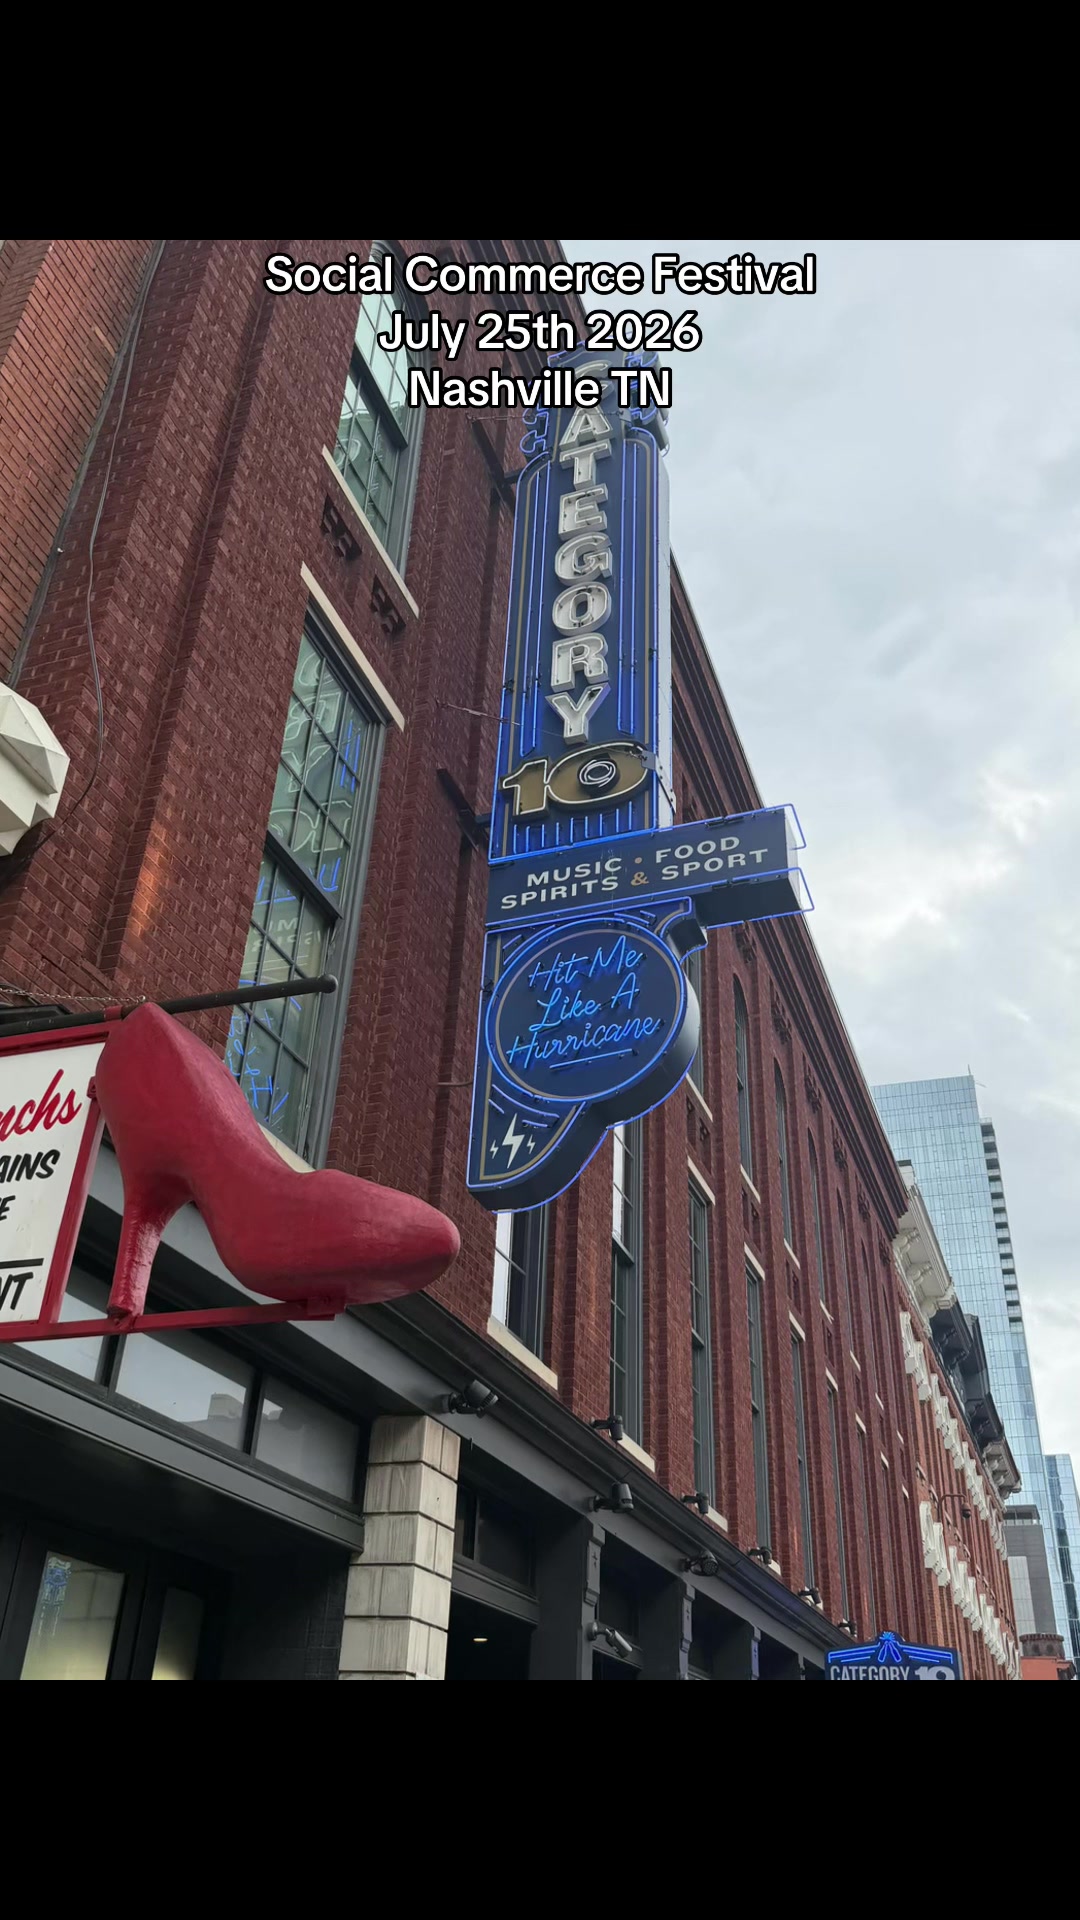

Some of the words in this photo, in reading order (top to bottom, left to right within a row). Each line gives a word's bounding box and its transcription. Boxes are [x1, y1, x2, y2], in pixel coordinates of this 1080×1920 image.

[499, 740, 654, 820] 10
[501, 876, 618, 909] SPIRITS
[630, 871, 650, 886] &
[661, 848, 768, 881] SPORT
[527, 857, 622, 887] MUSIC
[655, 836, 740, 864] FOOD
[528, 952, 589, 991] Hit
[589, 935, 645, 978] Me
[528, 987, 601, 1032] Like
[611, 972, 641, 1009] A
[506, 1016, 662, 1069] Hurricane
[830, 1665, 910, 1680] CATEGORY
